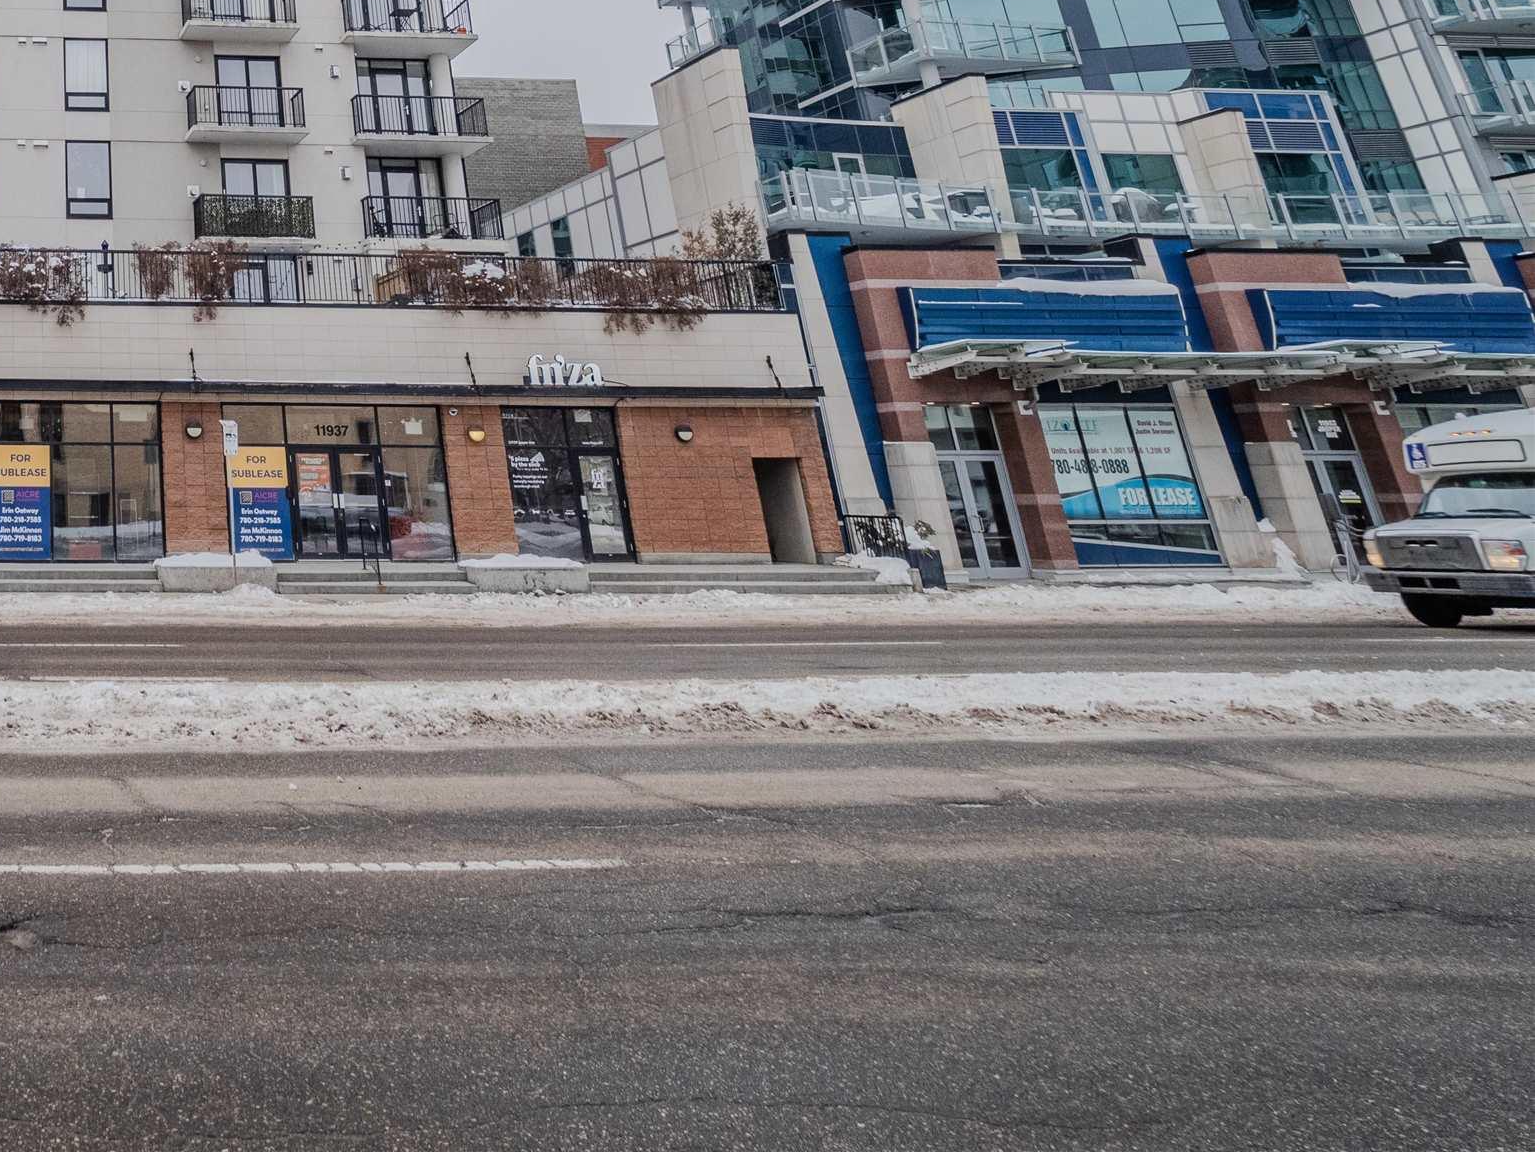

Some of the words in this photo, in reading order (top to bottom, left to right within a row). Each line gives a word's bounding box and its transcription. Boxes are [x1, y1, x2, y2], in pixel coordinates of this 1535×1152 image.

[313, 424, 349, 436] 11937
[10, 454, 31, 462] FOR
[246, 455, 267, 463] FOR
[231, 469, 283, 478] SUBLEASE
[1118, 488, 1148, 506] FOR
[1152, 488, 1196, 506] LEASE
[0, 526, 11, 534] Jim
[11, 526, 43, 534] McKinnon
